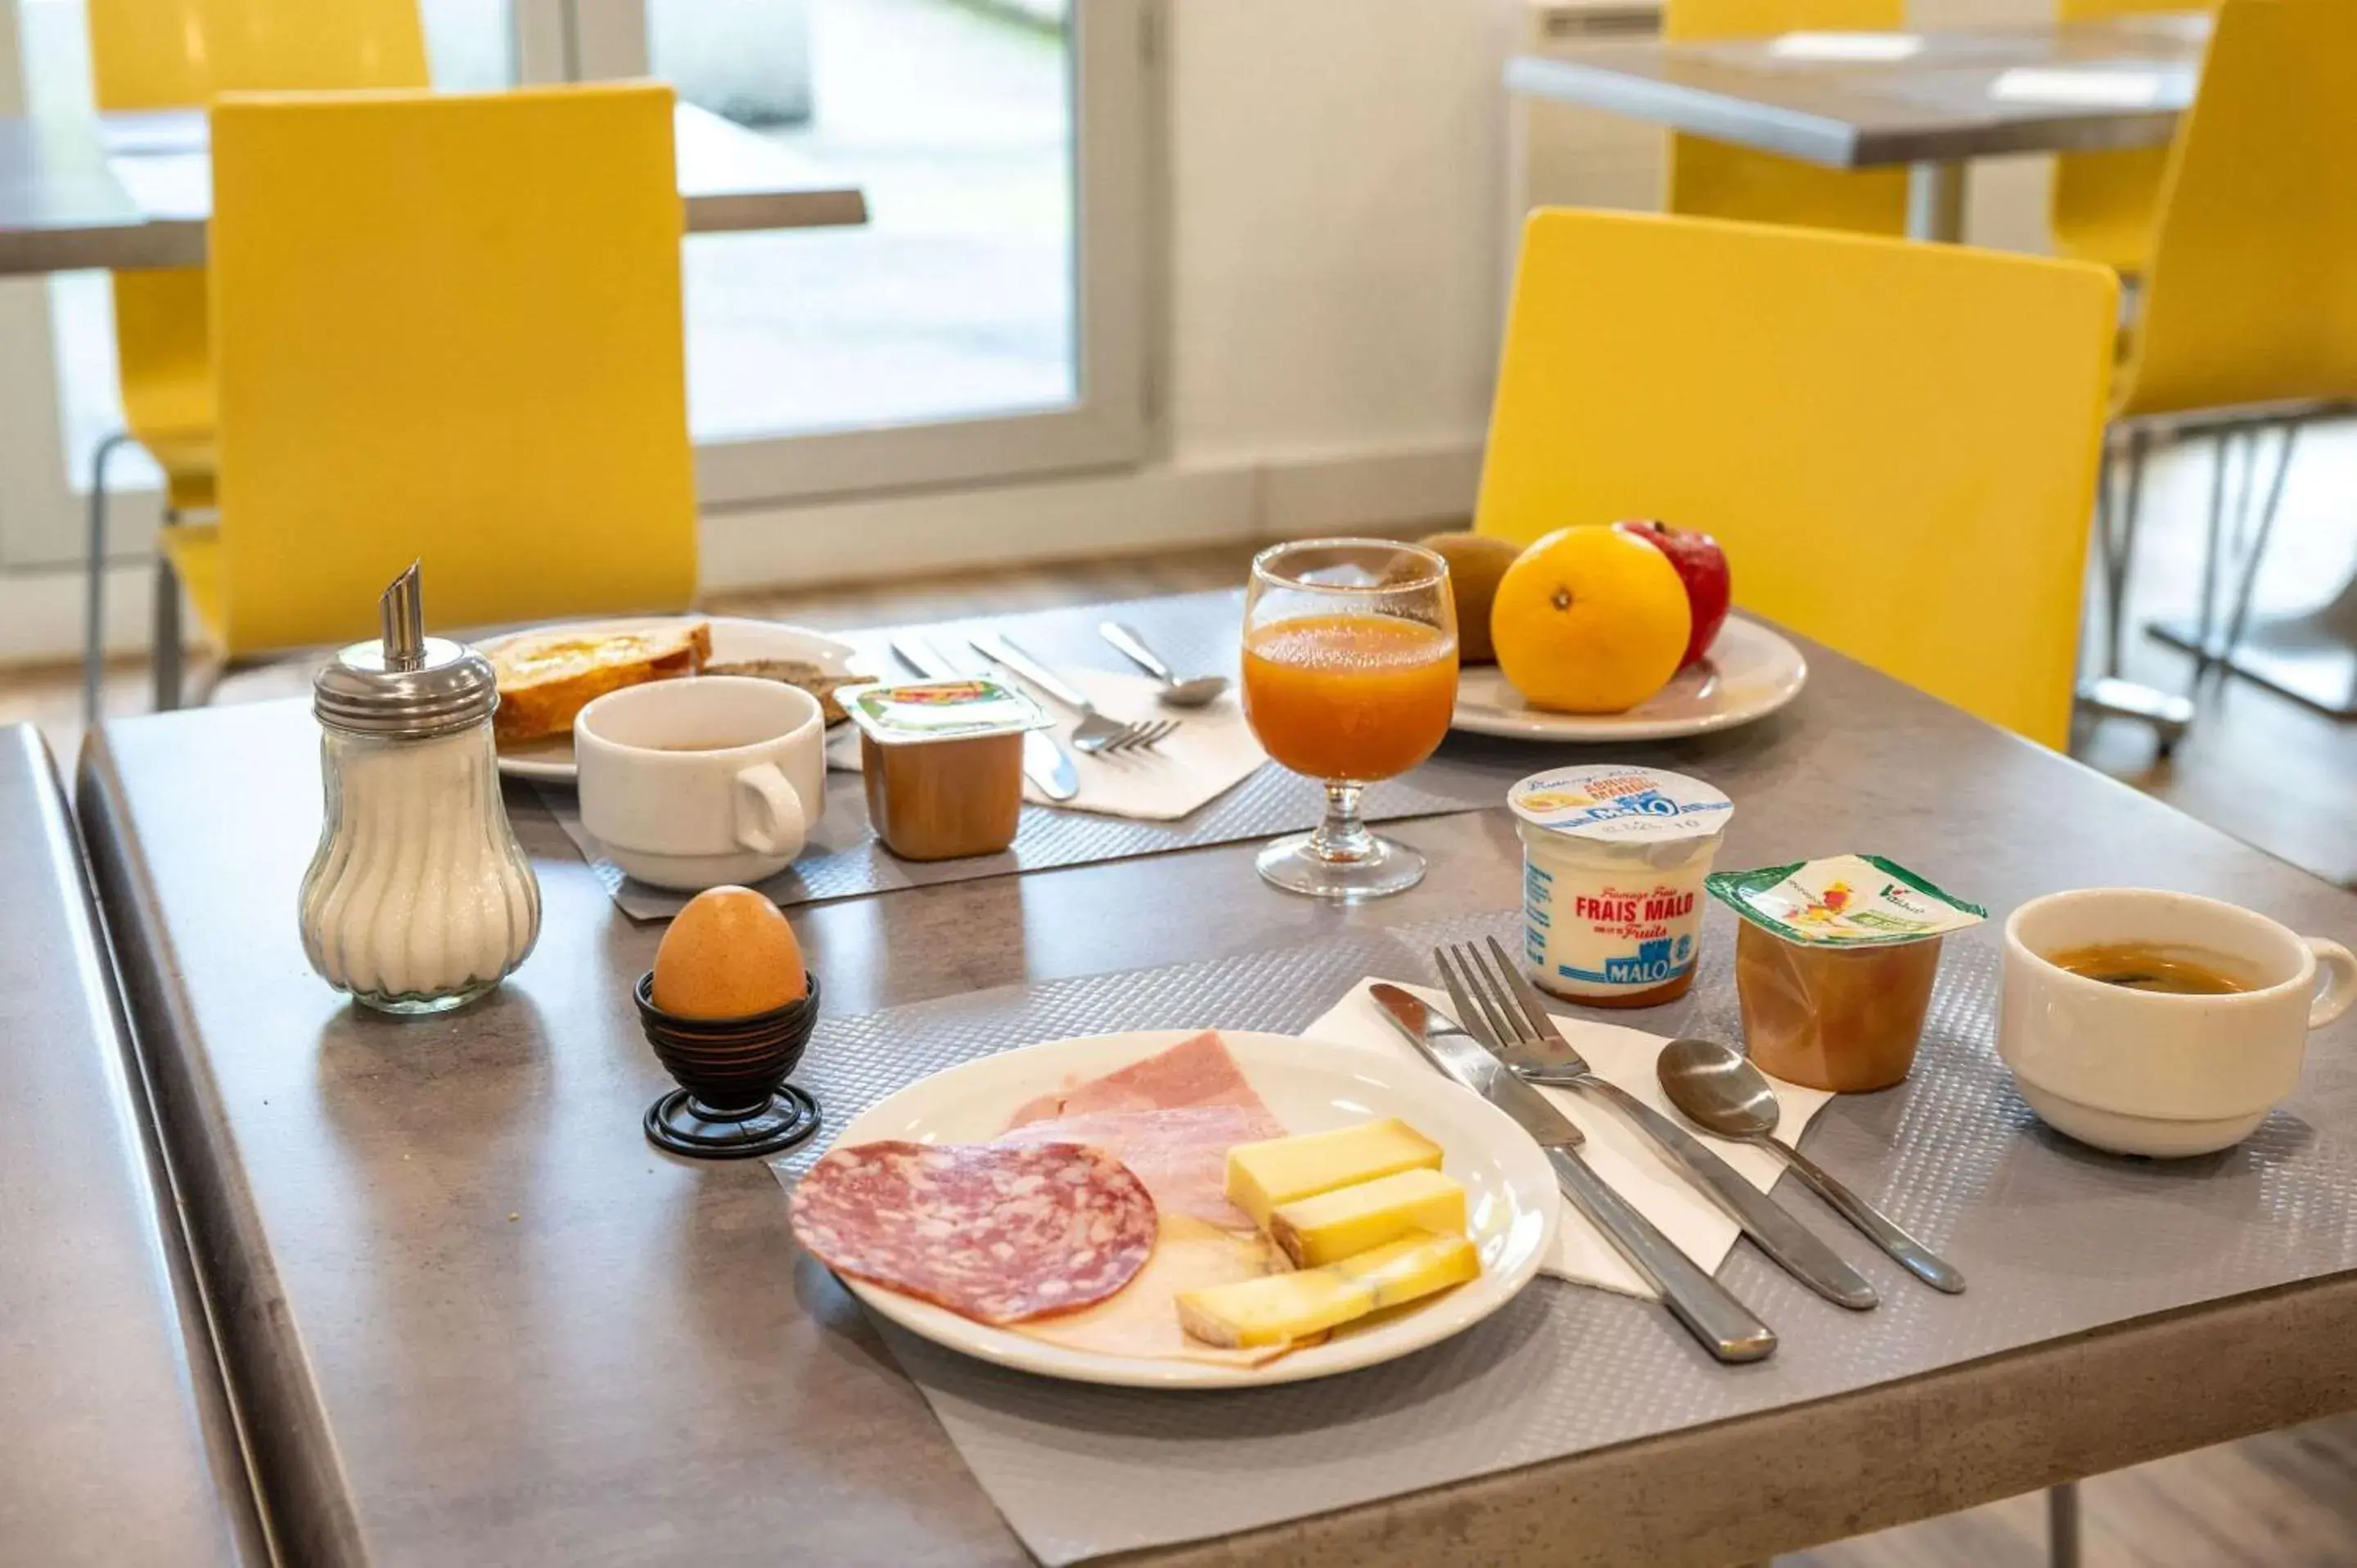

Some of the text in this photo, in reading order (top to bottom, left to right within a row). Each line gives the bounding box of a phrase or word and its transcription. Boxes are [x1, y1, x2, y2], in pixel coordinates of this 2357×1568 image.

[1575, 896, 1637, 922] FRAIS
[1644, 892, 1693, 921] MALO
[1621, 924, 1667, 939] Fruits
[1610, 960, 1668, 982] MALO
